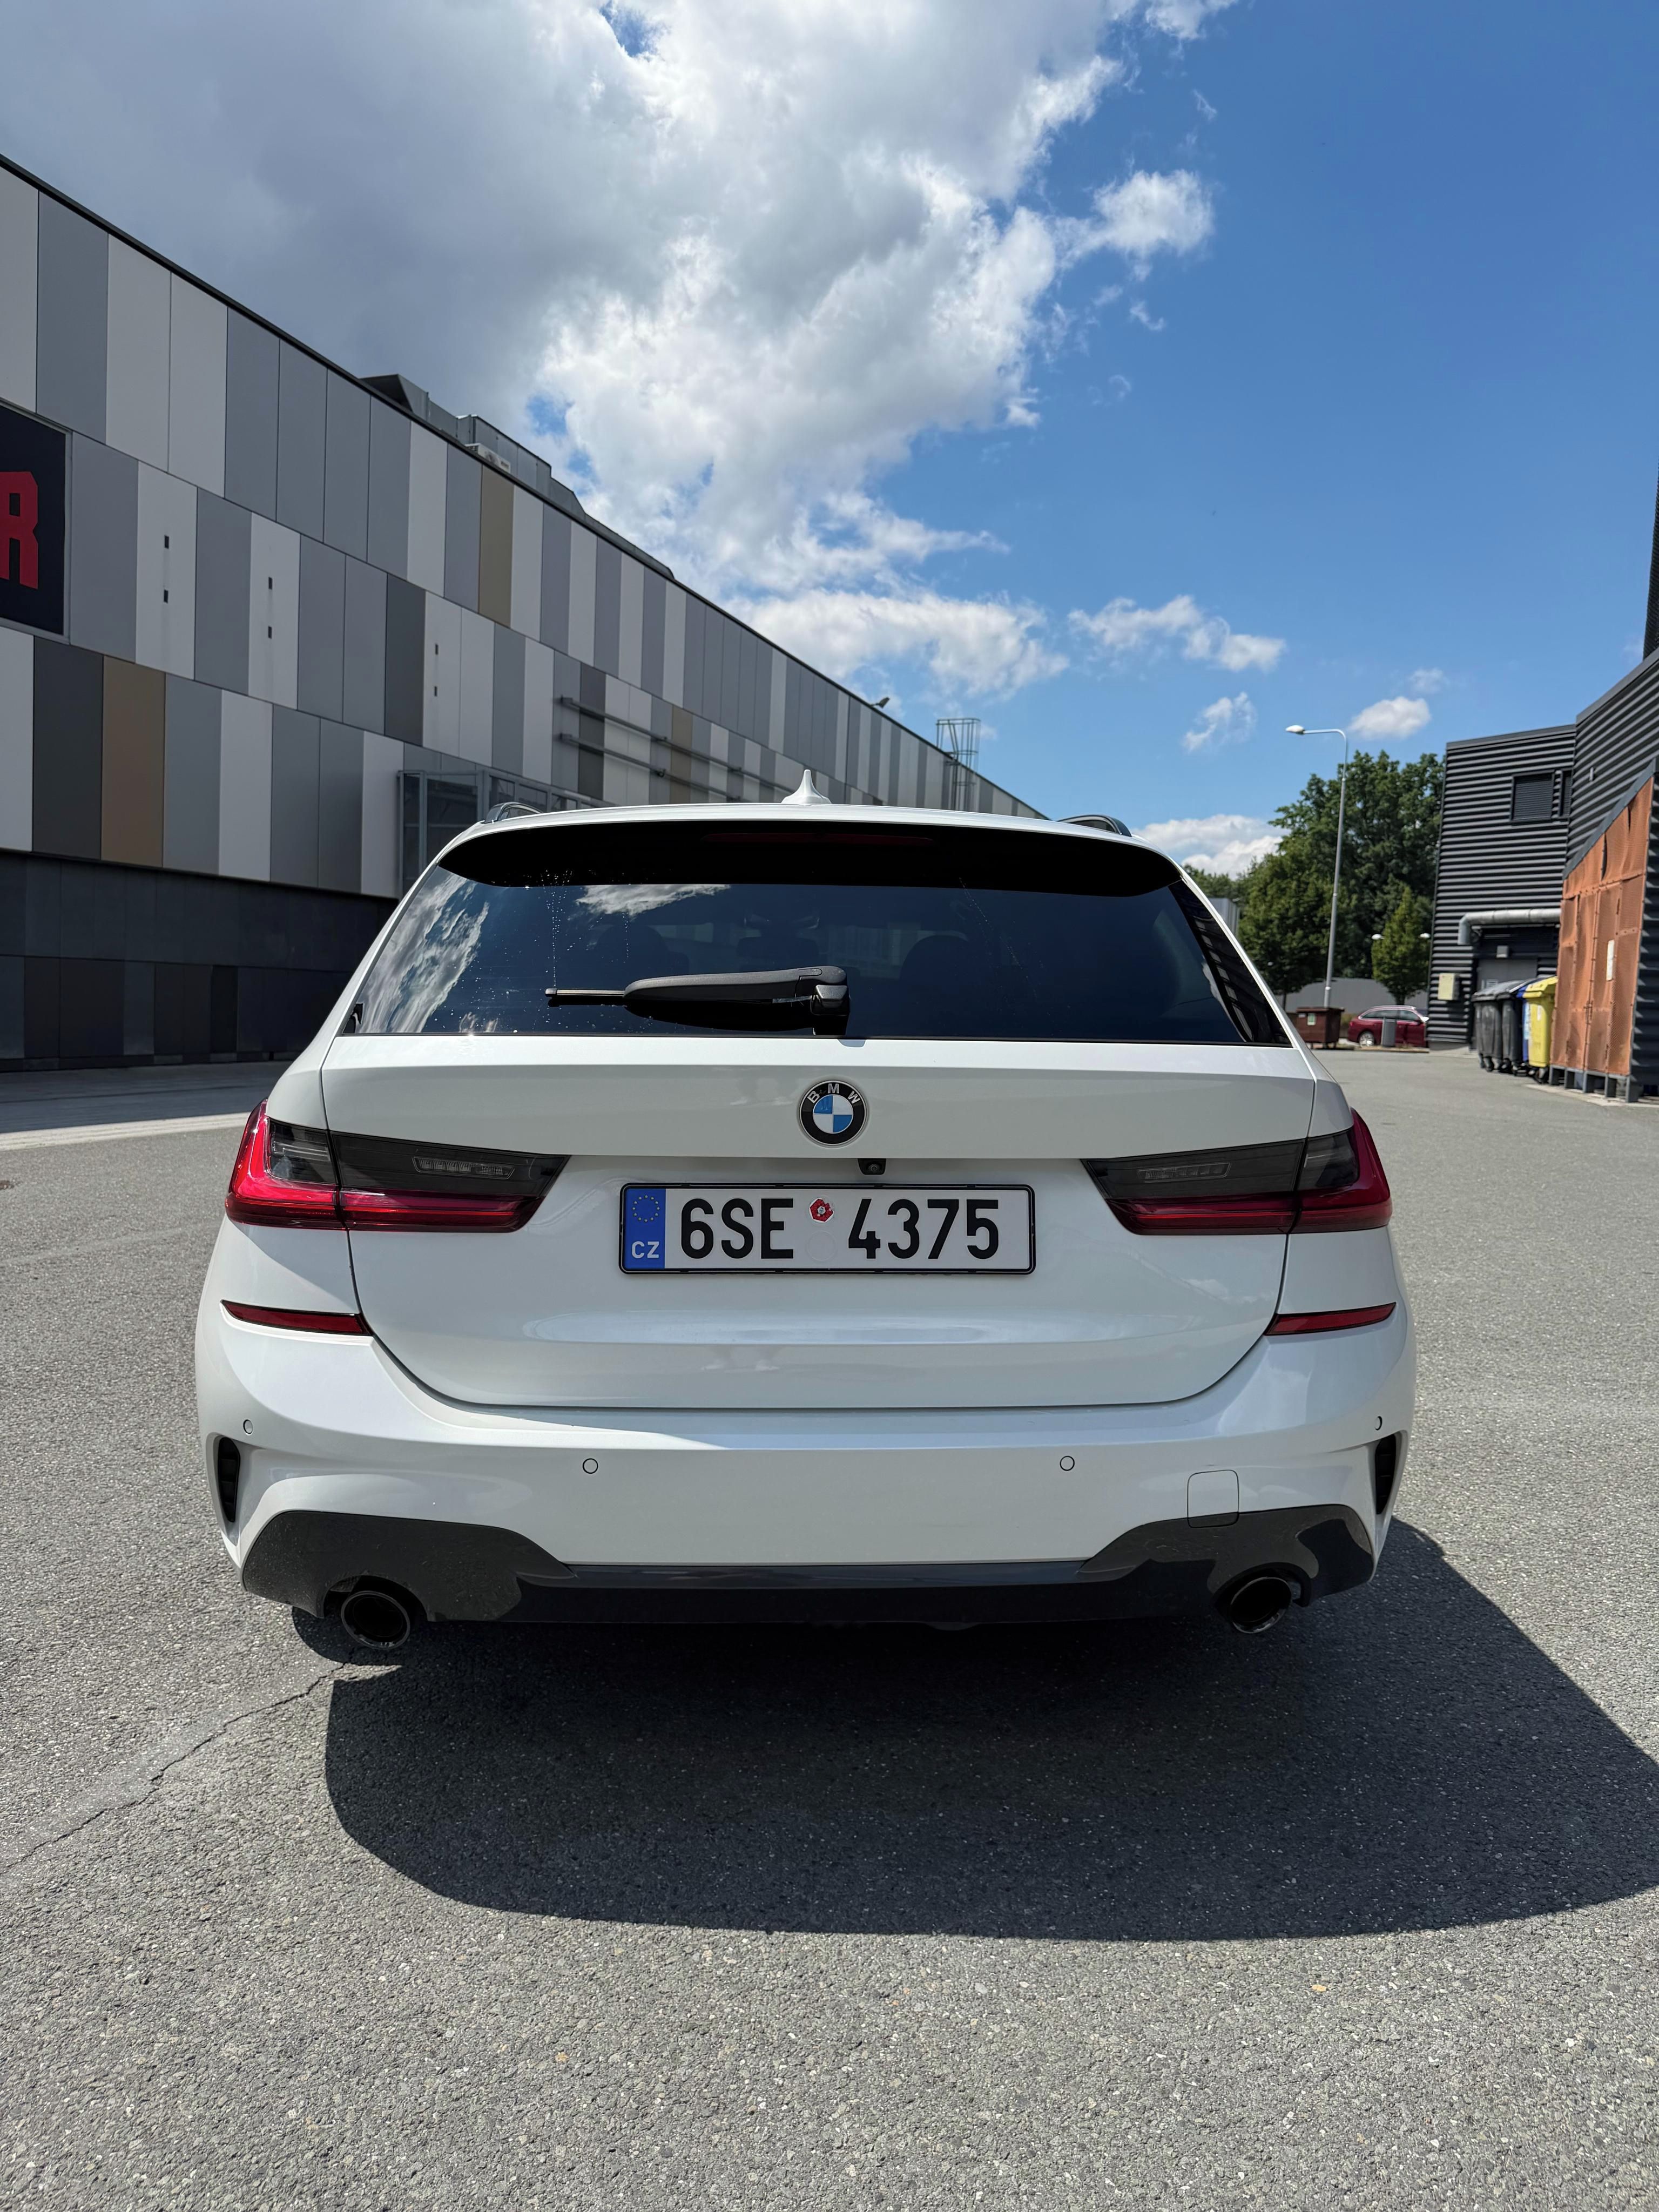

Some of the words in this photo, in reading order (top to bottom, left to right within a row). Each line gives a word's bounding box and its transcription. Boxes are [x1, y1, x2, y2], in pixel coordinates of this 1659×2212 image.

[807, 1083, 860, 1104] BMW
[680, 1198, 794, 1259] 6SE
[848, 1198, 999, 1259] 4375
[631, 1240, 659, 1258] CZ
